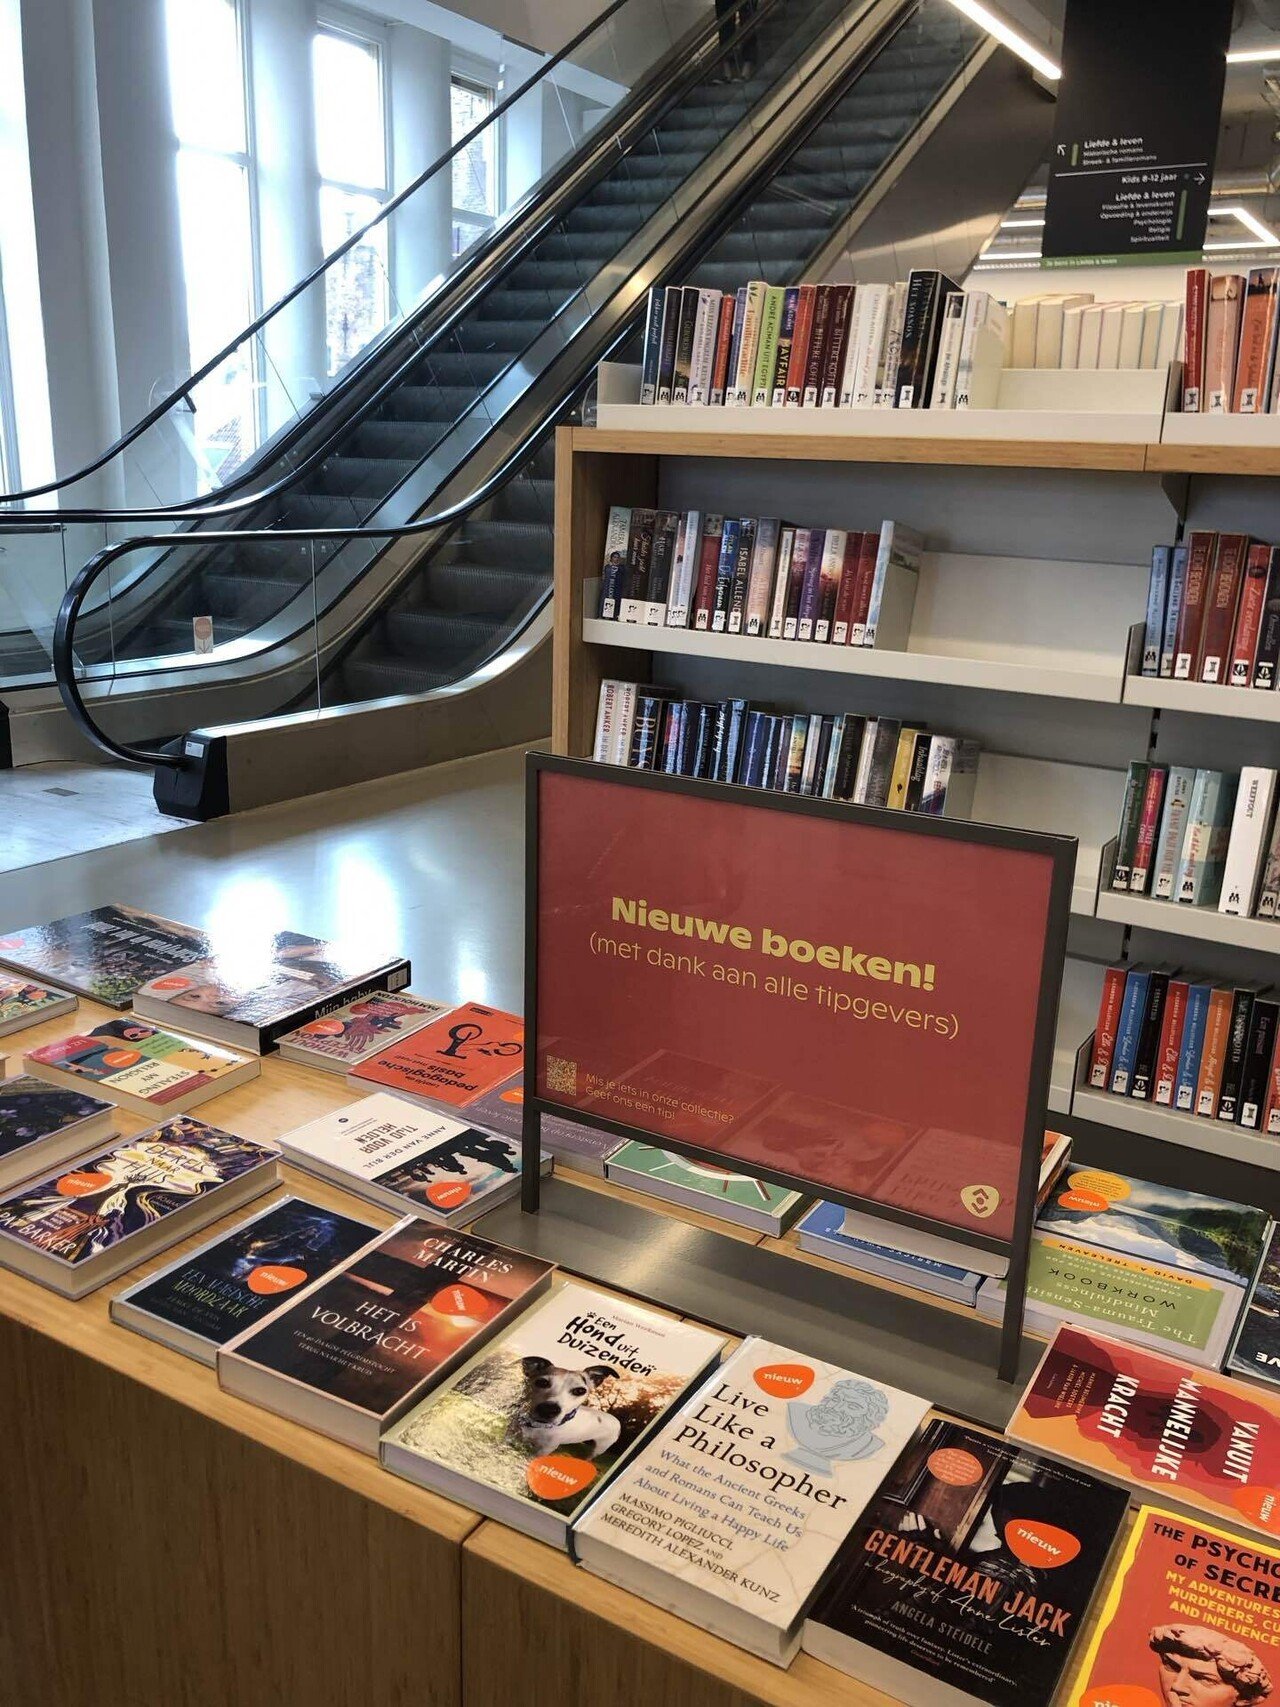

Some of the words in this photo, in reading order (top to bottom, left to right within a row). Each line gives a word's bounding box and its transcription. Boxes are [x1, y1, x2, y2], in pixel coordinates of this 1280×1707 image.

[1084, 139, 1110, 149] Liefde
[1120, 137, 1143, 145] leven
[1122, 175, 1140, 184] Kids
[1160, 173, 1178, 182] jaar
[1115, 192, 1141, 201] Liefde
[1151, 190, 1175, 199] leven
[768, 296, 778, 320] ANDRÉ
[764, 322, 774, 350] ACIMAN
[776, 339, 791, 386] MAYFAIR
[736, 548, 748, 577] ISABEL
[605, 685, 614, 710] ROBERT
[603, 711, 613, 733] ANKER
[910, 746, 928, 782] Inhaalslag
[611, 896, 752, 950] Nieuwe
[761, 928, 936, 991] boeken!
[376, 991, 422, 1008] HOUSTON
[589, 931, 640, 962] (met
[647, 947, 706, 977] dank
[713, 962, 757, 989] aan
[764, 972, 809, 1001] alle
[815, 984, 960, 1040] tipgevers)
[109, 1062, 161, 1085] RELIGION
[138, 1070, 190, 1095] STEALING
[142, 1073, 160, 1084] MY
[377, 1059, 478, 1091] pedagogische
[426, 1063, 466, 1080] basis
[586, 1073, 604, 1087] Mis
[604, 1079, 616, 1090] je
[617, 1082, 637, 1095] iets
[639, 1088, 650, 1099] in
[652, 1092, 679, 1107] onze
[681, 1100, 735, 1125] collectie?
[586, 1086, 611, 1100] Geef
[613, 1094, 633, 1108] ons
[635, 1099, 655, 1113] een
[656, 1103, 676, 1120] tip!
[354, 1123, 397, 1143] HELDEN
[359, 1134, 392, 1154] VOOR
[394, 1125, 419, 1140] TIJD
[402, 1137, 421, 1152] VAN
[420, 1126, 446, 1143] ANNE
[383, 1146, 402, 1161] DER
[19, 1221, 77, 1255] BARKER
[414, 1248, 491, 1284] MARTIN
[423, 1237, 513, 1275] CHARLES
[1058, 1244, 1128, 1267] TRELEAVEN
[1047, 1266, 1177, 1310] WORKBOOK
[1153, 1269, 1193, 1284] DAVID
[1023, 1284, 1157, 1330] Trauma-Sensiti
[1054, 1280, 1160, 1318] Mindfulness
[310, 1306, 431, 1361] VOLBRACHT
[356, 1301, 400, 1324] HET
[399, 1317, 422, 1333] IS
[594, 1315, 618, 1331] Een
[565, 1315, 625, 1347] Hond
[617, 1341, 640, 1357] uit
[1161, 1324, 1197, 1344] The
[557, 1331, 652, 1377] Duizenden
[763, 1371, 804, 1388] nieuw
[711, 1383, 770, 1418] Live
[1097, 1373, 1140, 1438] KRACHT
[692, 1404, 755, 1440] Like
[760, 1434, 776, 1450] a
[1151, 1377, 1203, 1481] MANNELIJKE
[673, 1424, 848, 1512] Philosopher
[1222, 1420, 1260, 1484] VANUIT
[539, 1463, 579, 1486] nieuw
[661, 1450, 691, 1470] What
[692, 1460, 712, 1477] the
[715, 1469, 762, 1501] Ancient
[763, 1493, 807, 1521] Greeks
[633, 1476, 670, 1500] About
[672, 1490, 709, 1521] Living
[711, 1510, 721, 1521] a
[723, 1514, 762, 1541] Happy
[765, 1531, 790, 1553] Life
[645, 1463, 671, 1482] and
[670, 1471, 718, 1502] Romans
[720, 1493, 744, 1513] Can
[747, 1505, 785, 1530] Teach
[785, 1523, 805, 1539] Us
[610, 1502, 664, 1536] GREGORY
[665, 1526, 704, 1551] LOPEZ
[704, 1546, 724, 1561] AND
[619, 1492, 673, 1522] MASSIMO
[674, 1515, 734, 1552] PIGLIUCCI,
[1154, 1522, 1185, 1543] THE
[601, 1512, 663, 1548] MEREDITH
[664, 1539, 739, 1584] ALEXANDER
[739, 1578, 780, 1604] KUNZ
[1016, 1526, 1062, 1557] nieuw
[1175, 1553, 1199, 1571] OF
[864, 1528, 1000, 1606] GENTLEMAN
[1002, 1590, 1073, 1638] JACK
[1165, 1570, 1186, 1585] MY
[1190, 1577, 1280, 1620] ADVENTURES
[946, 1593, 998, 1623] Anne
[998, 1613, 1052, 1648] Lister
[1169, 1600, 1200, 1619] AND
[890, 1600, 936, 1630] ANGELA
[938, 1622, 993, 1656] STEIDELE
